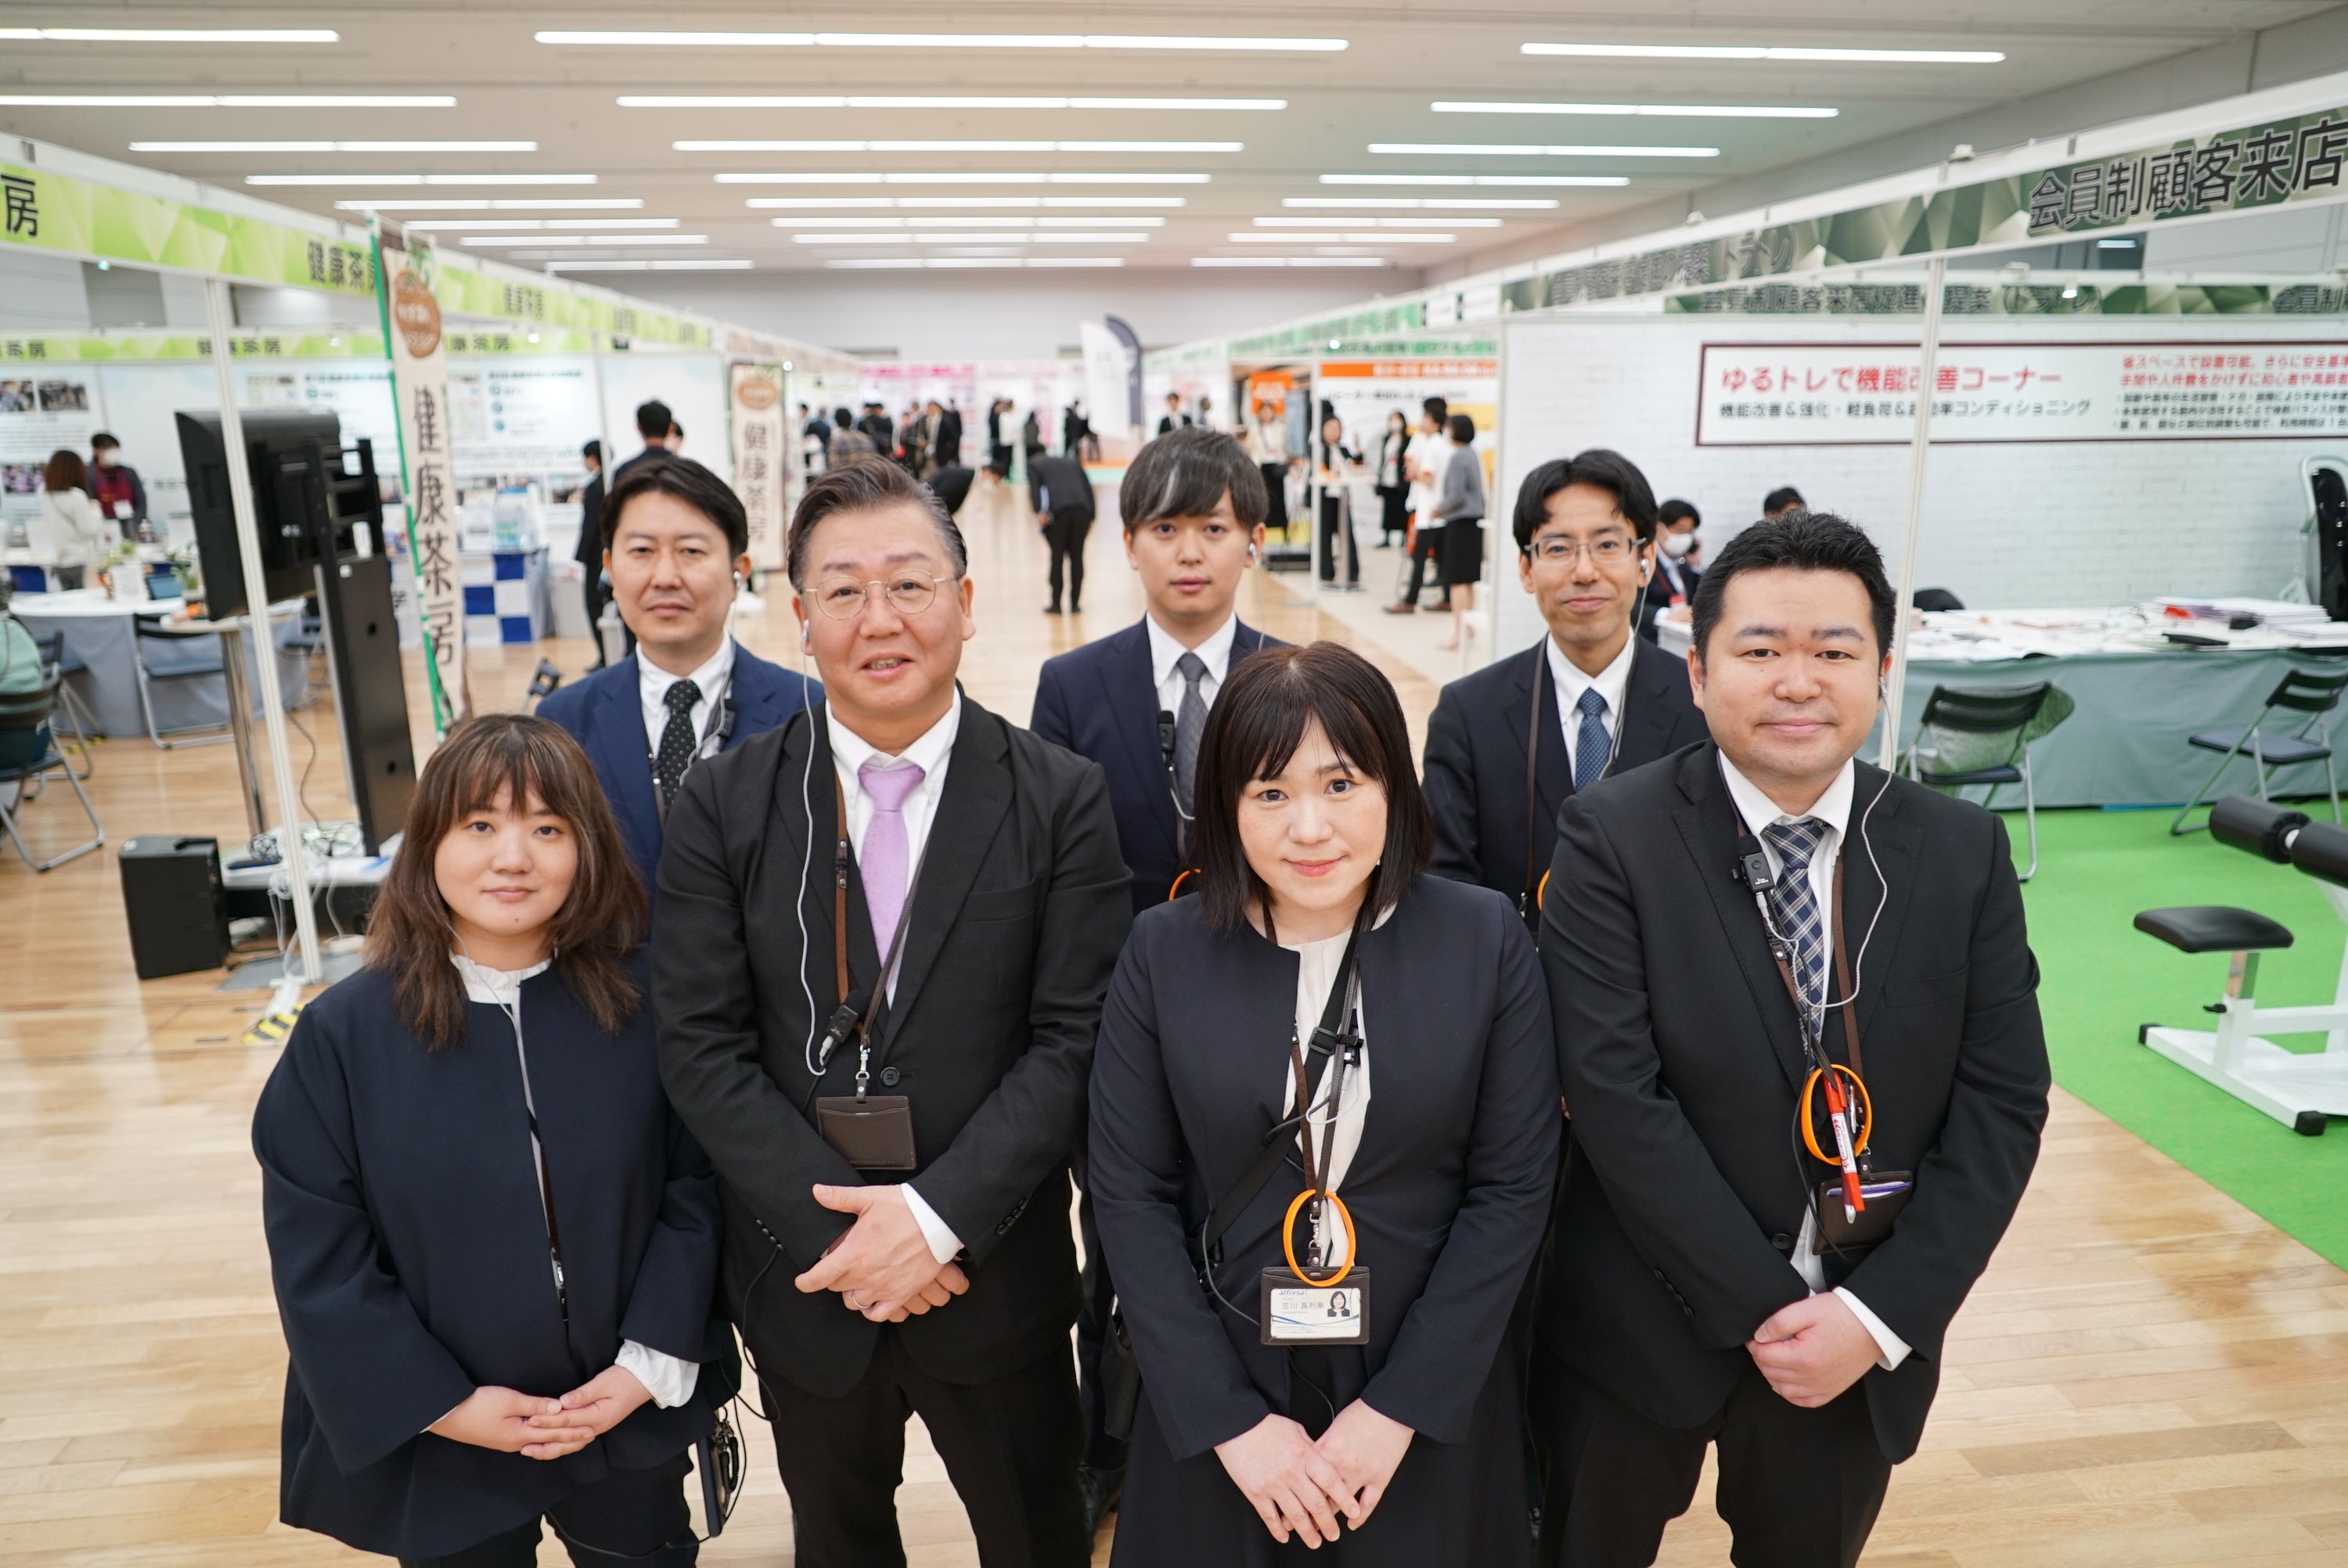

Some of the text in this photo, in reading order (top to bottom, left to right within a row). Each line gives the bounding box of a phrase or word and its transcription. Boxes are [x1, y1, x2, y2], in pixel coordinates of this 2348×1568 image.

[2029, 117, 2348, 232] 会員制顧客来店
[0, 174, 38, 236] 房
[1701, 284, 1991, 313] 会員制顧客来店促進提案
[2274, 286, 2348, 313] 会員制
